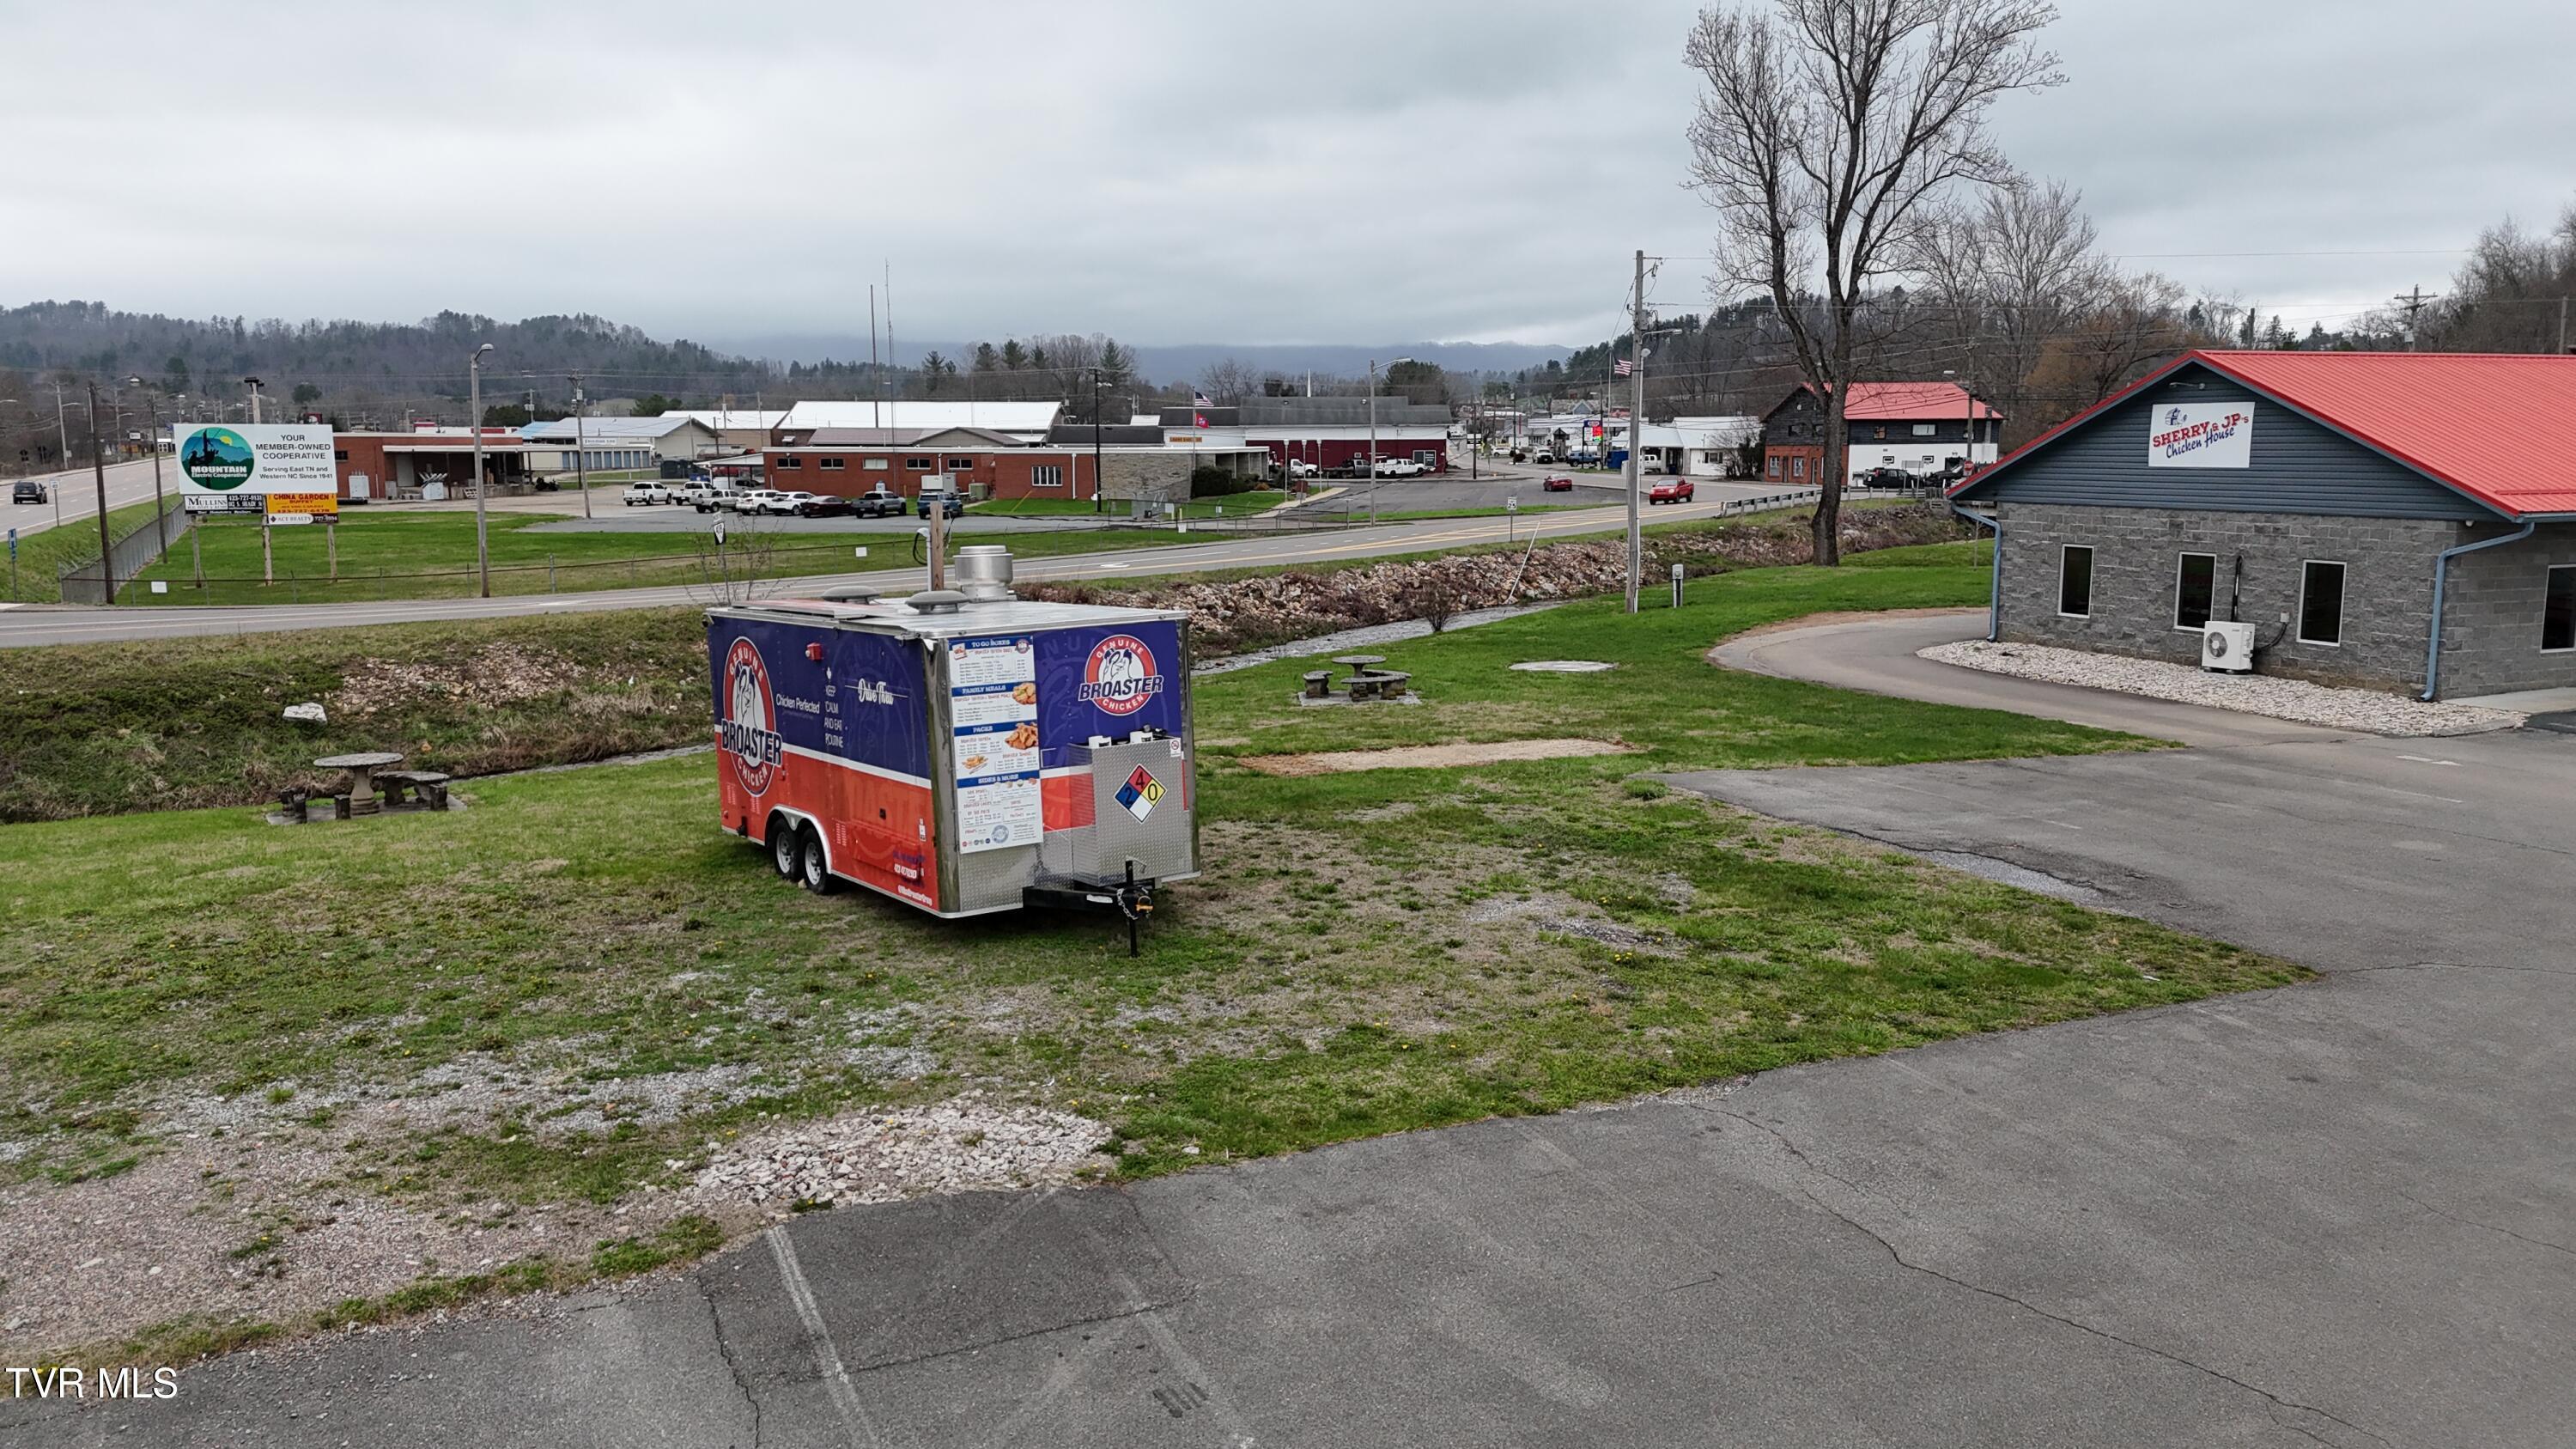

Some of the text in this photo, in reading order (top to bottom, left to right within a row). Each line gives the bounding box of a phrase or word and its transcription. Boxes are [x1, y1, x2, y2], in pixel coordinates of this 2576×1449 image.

[2153, 421, 2210, 447] SHERRY
[2212, 423, 2219, 432] &
[2166, 427, 2235, 458] Chicken House
[188, 497, 227, 505] MULLINS
[1096, 639, 1144, 658] GENUINE
[729, 646, 763, 682] GENUINE
[858, 678, 894, 705] Drive Thru
[1079, 676, 1163, 700] BROASTER
[776, 693, 820, 714] Chicken Perfected
[1102, 694, 1144, 710] CHICKEN
[824, 717, 834, 729] AND
[722, 719, 782, 766] BROASTER
[738, 757, 767, 786] CHICKEN
[1136, 771, 1144, 790] 4
[1125, 783, 1157, 805] 2 0
